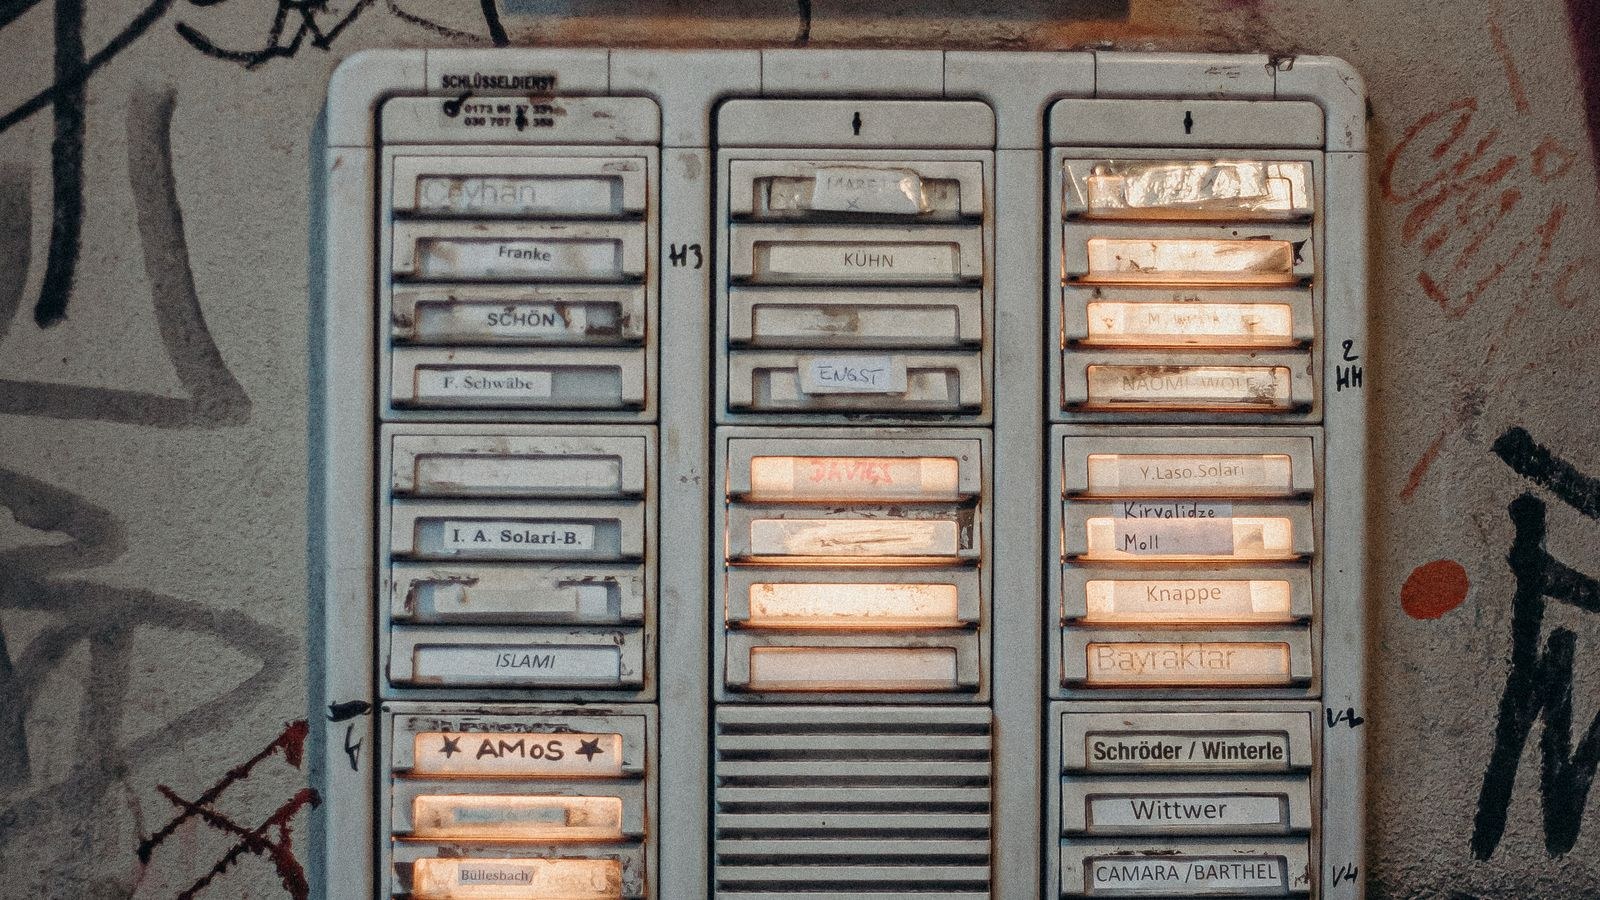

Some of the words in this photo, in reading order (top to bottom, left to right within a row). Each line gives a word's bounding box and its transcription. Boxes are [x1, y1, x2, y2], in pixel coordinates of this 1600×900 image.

[442, 72, 556, 90] SCHLÜSSELDIENST
[498, 245, 552, 262] Franke
[843, 251, 895, 269] KÜHN
[487, 308, 556, 328] SCHÖN
[1342, 339, 1359, 361] 2
[443, 376, 459, 390] F.
[463, 375, 534, 390] Schwäbe
[816, 365, 884, 386] ENGST
[1123, 501, 1216, 519] Kirvalidze
[452, 529, 465, 543] I.
[473, 529, 491, 543] A.
[500, 529, 582, 545] Solari-B.
[1124, 533, 1159, 551] Moll
[1146, 585, 1222, 605] Knappe
[495, 653, 556, 669] ISLAMI
[1095, 645, 1237, 674] Bayraktar
[1093, 740, 1182, 761] Schröder
[1188, 741, 1196, 760] /
[1202, 740, 1284, 761] Winterle
[1130, 799, 1228, 820] Wittwer
[1096, 864, 1180, 883] CAMARA
[1185, 862, 1278, 884] /BARTHEL
